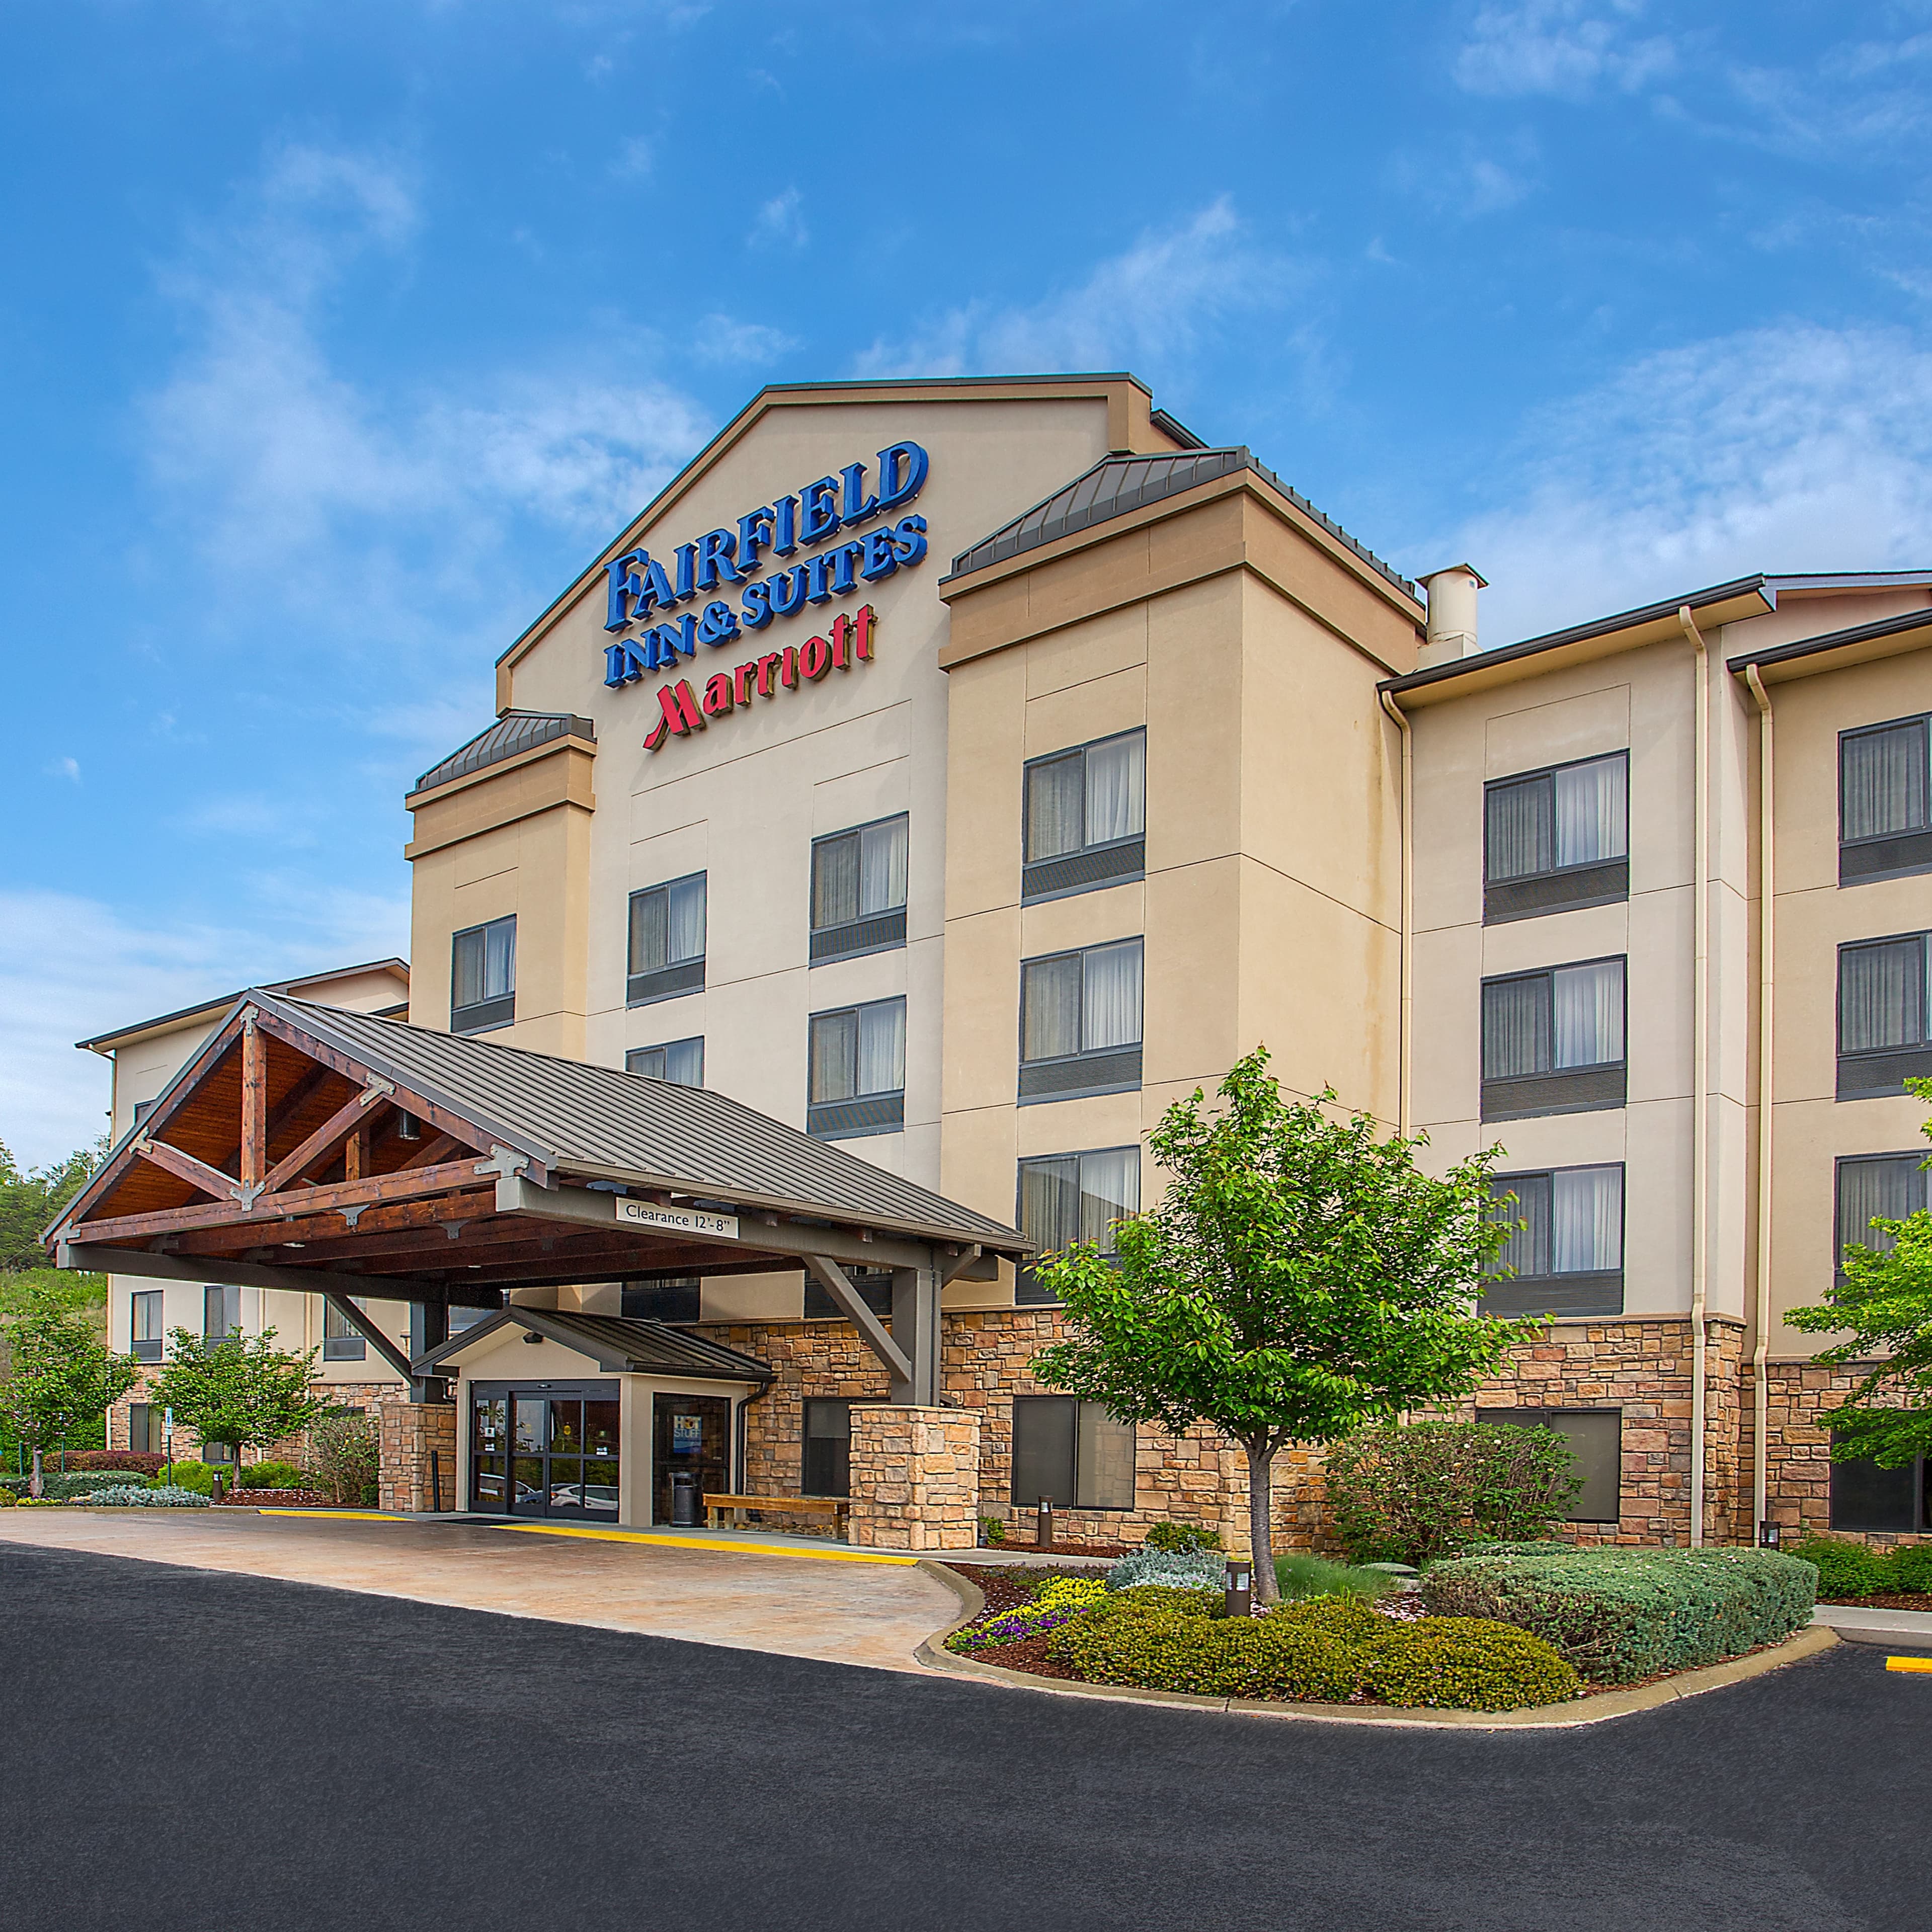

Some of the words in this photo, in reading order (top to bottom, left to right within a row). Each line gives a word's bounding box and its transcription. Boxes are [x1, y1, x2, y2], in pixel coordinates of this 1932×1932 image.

[604, 440, 929, 632] FAIRFIELD
[643, 604, 878, 752] Marriott
[626, 1204, 689, 1226] Clearance
[674, 1415, 701, 1429] HOT
[674, 1429, 700, 1437] STUFF
